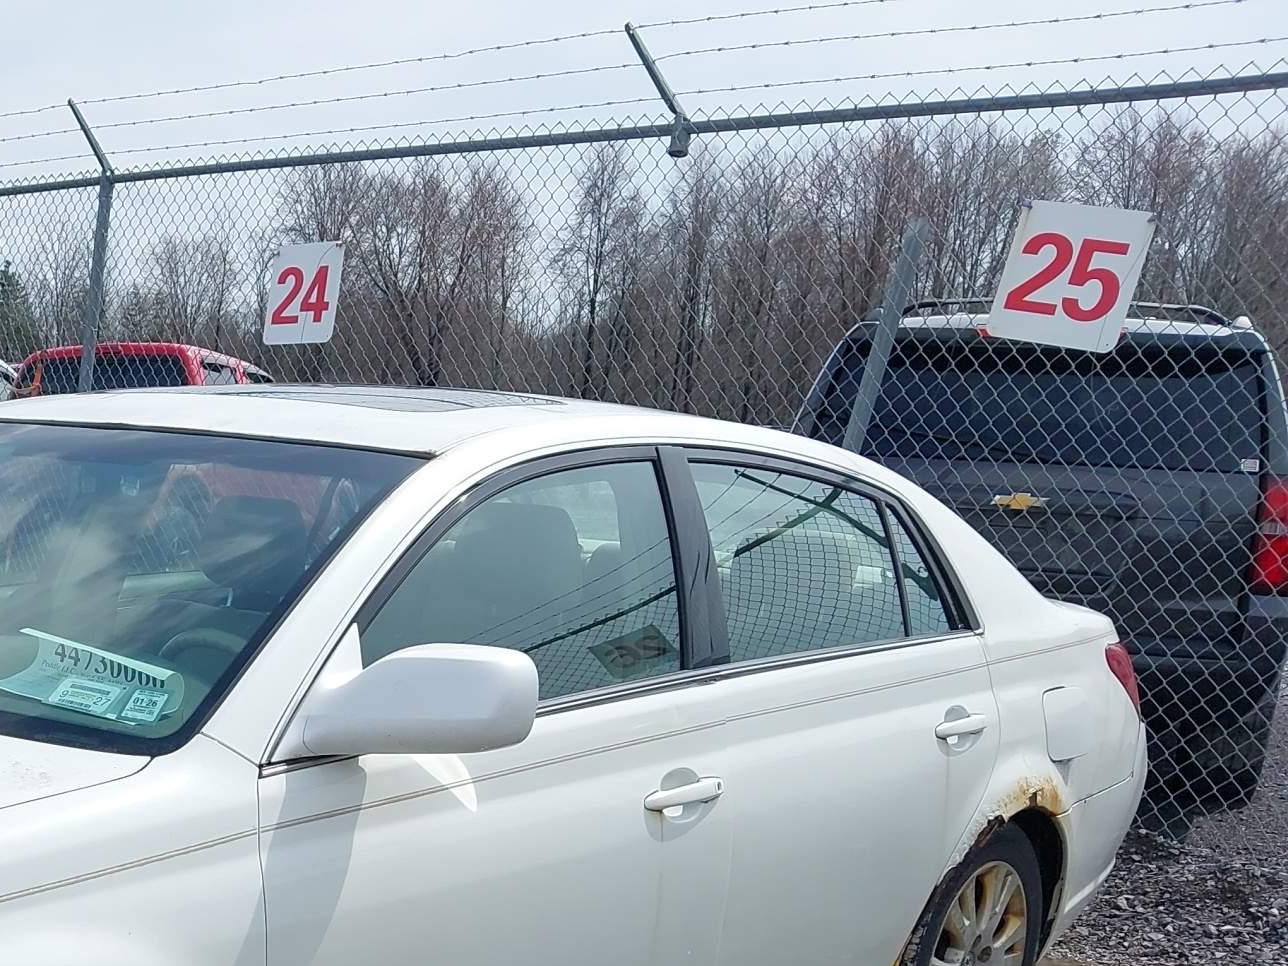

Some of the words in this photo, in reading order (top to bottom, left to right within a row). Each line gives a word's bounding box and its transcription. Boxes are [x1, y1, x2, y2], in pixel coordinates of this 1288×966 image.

[1003, 232, 1131, 322] 25
[270, 265, 330, 326] 24
[59, 689, 70, 699] 9
[92, 696, 112, 707] 27
